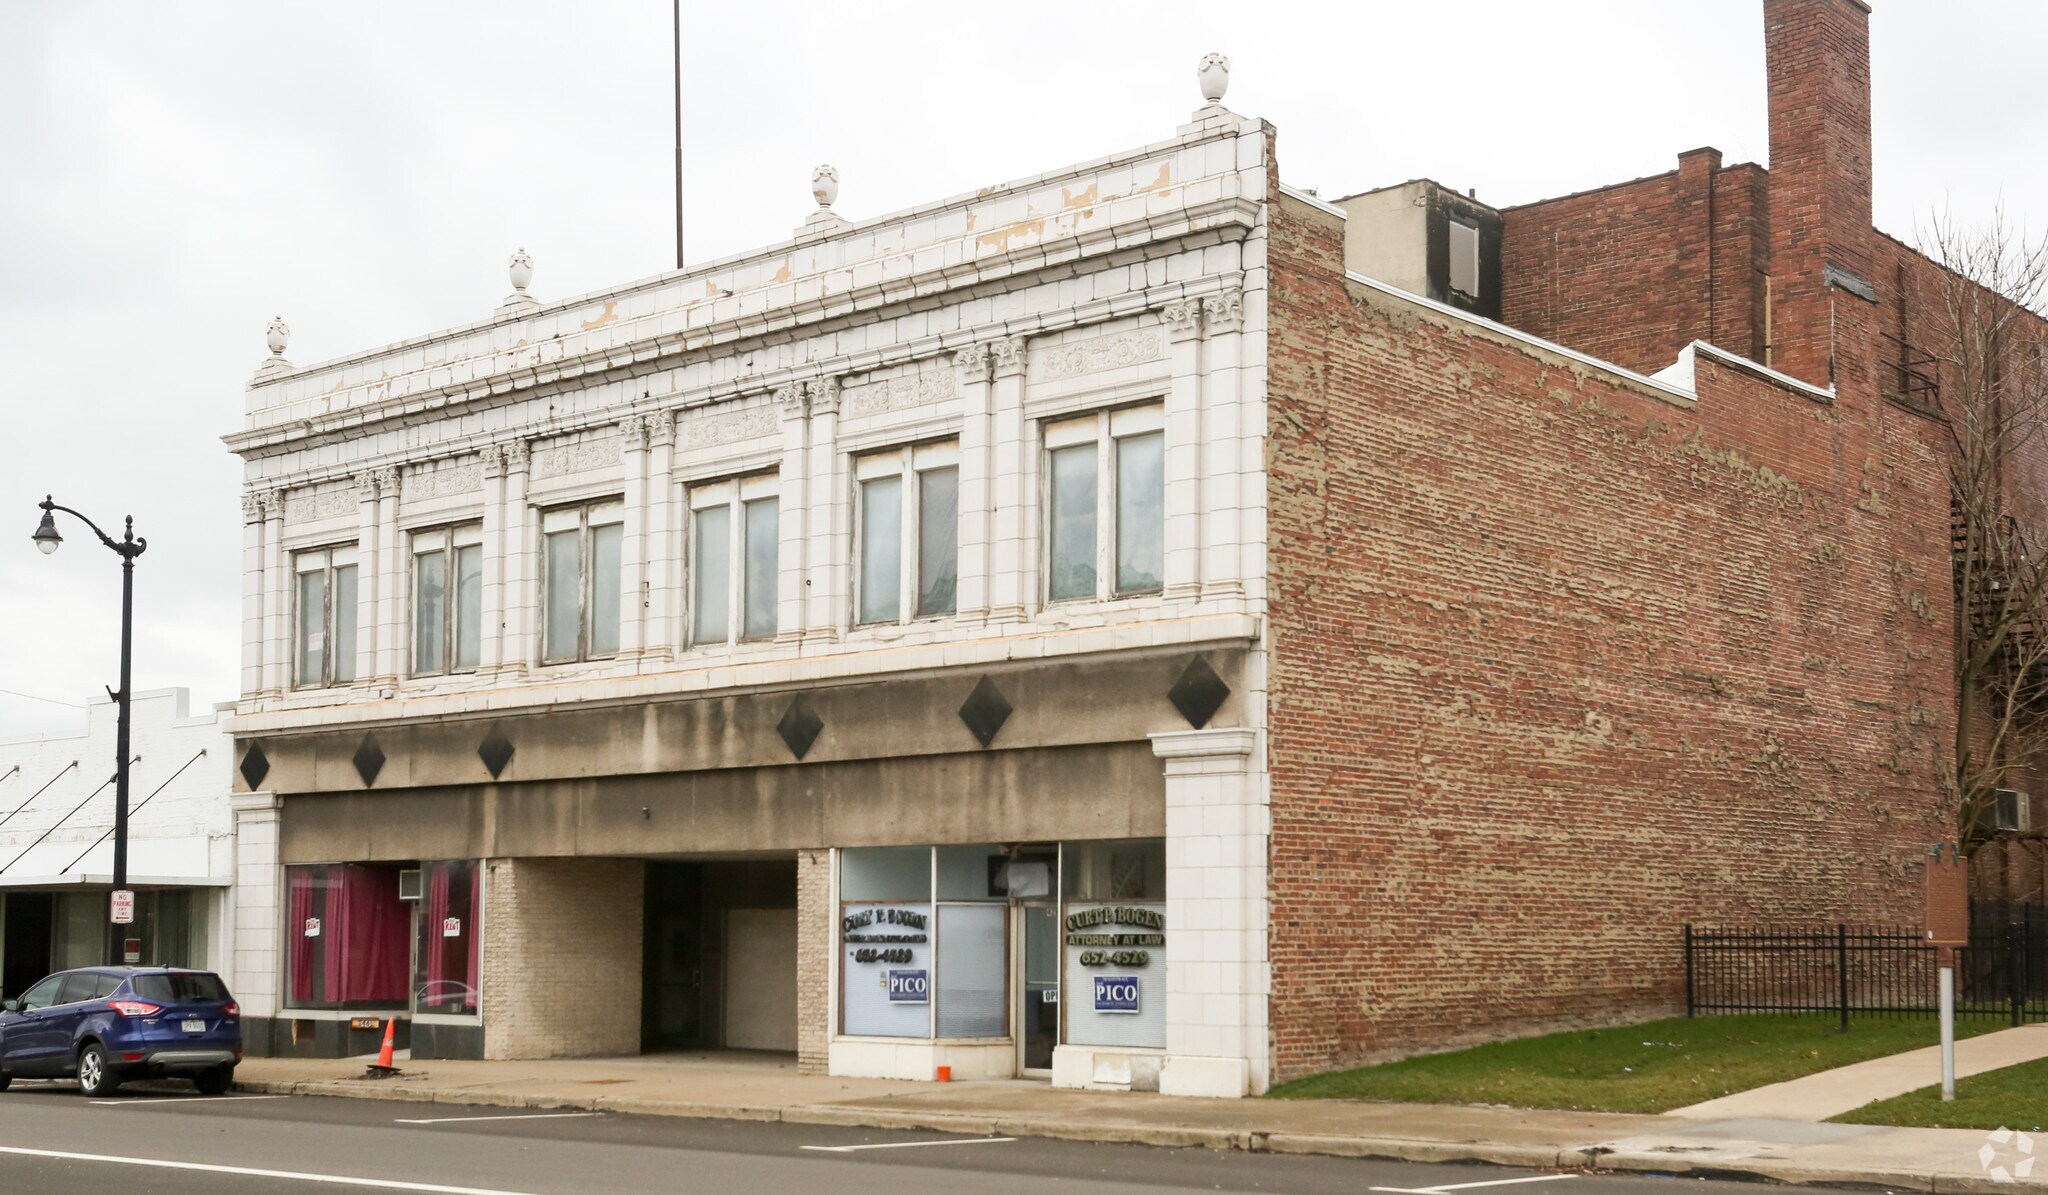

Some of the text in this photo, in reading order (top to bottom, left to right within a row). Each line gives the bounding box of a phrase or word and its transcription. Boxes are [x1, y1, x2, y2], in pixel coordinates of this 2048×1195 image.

[1067, 909, 1101, 931] CURT
[1115, 907, 1164, 930] BOGEN
[1068, 935, 1162, 945] ATTORNEY AT LAW
[1081, 950, 1149, 967] 652-4529
[891, 978, 926, 993] PICO
[1096, 985, 1137, 1001] PICO
